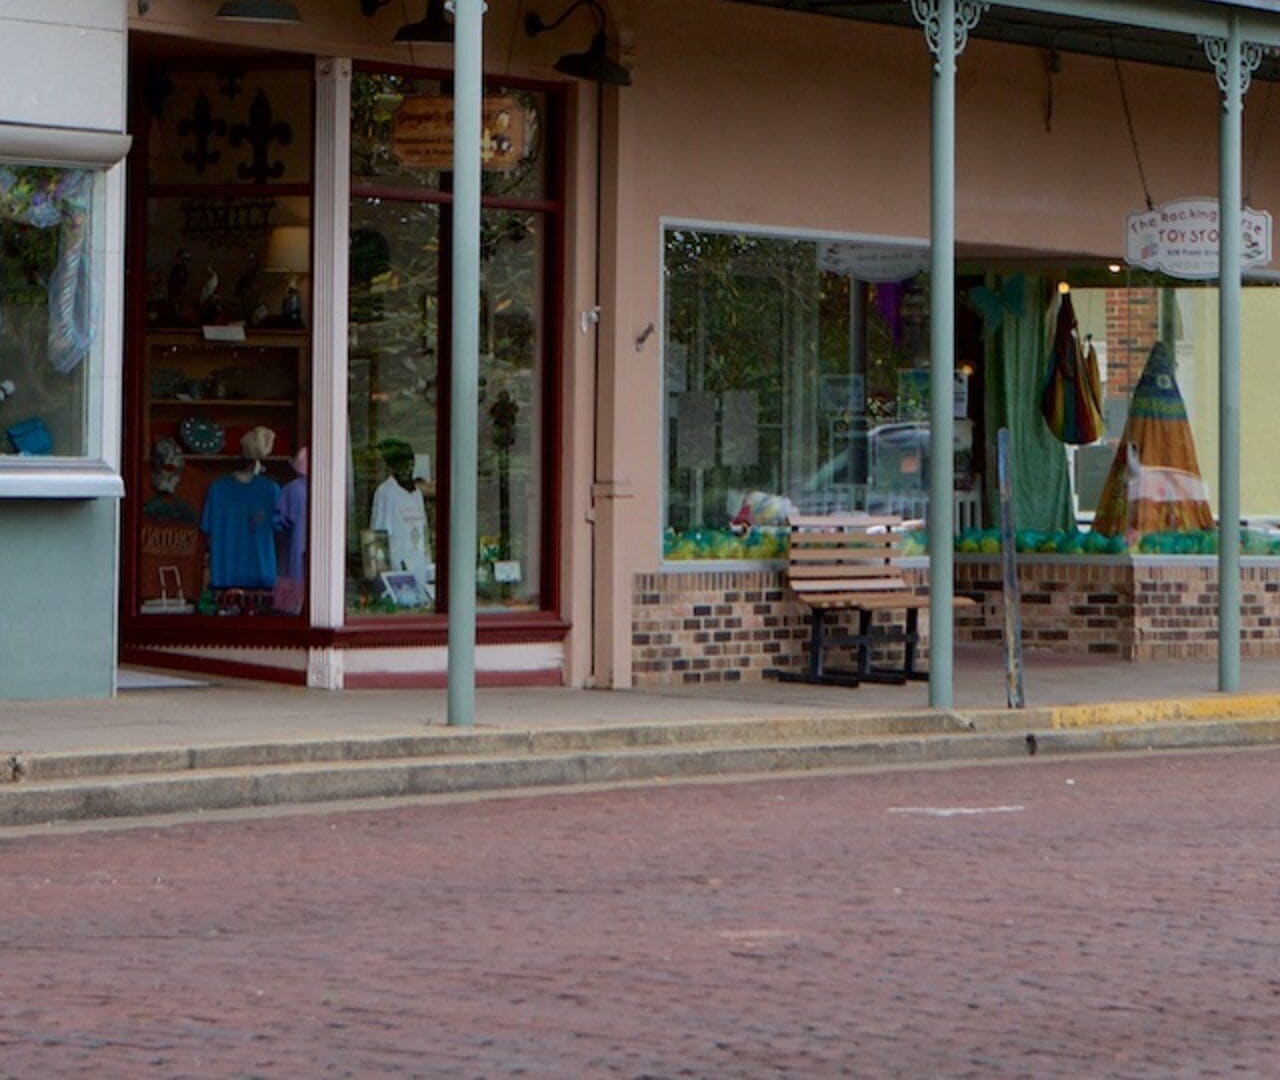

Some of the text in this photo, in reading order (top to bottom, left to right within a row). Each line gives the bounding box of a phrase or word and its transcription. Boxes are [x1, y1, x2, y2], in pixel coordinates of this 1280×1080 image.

[1130, 208, 1262, 236] The Rocking rse
[1189, 229, 1220, 243] STO
